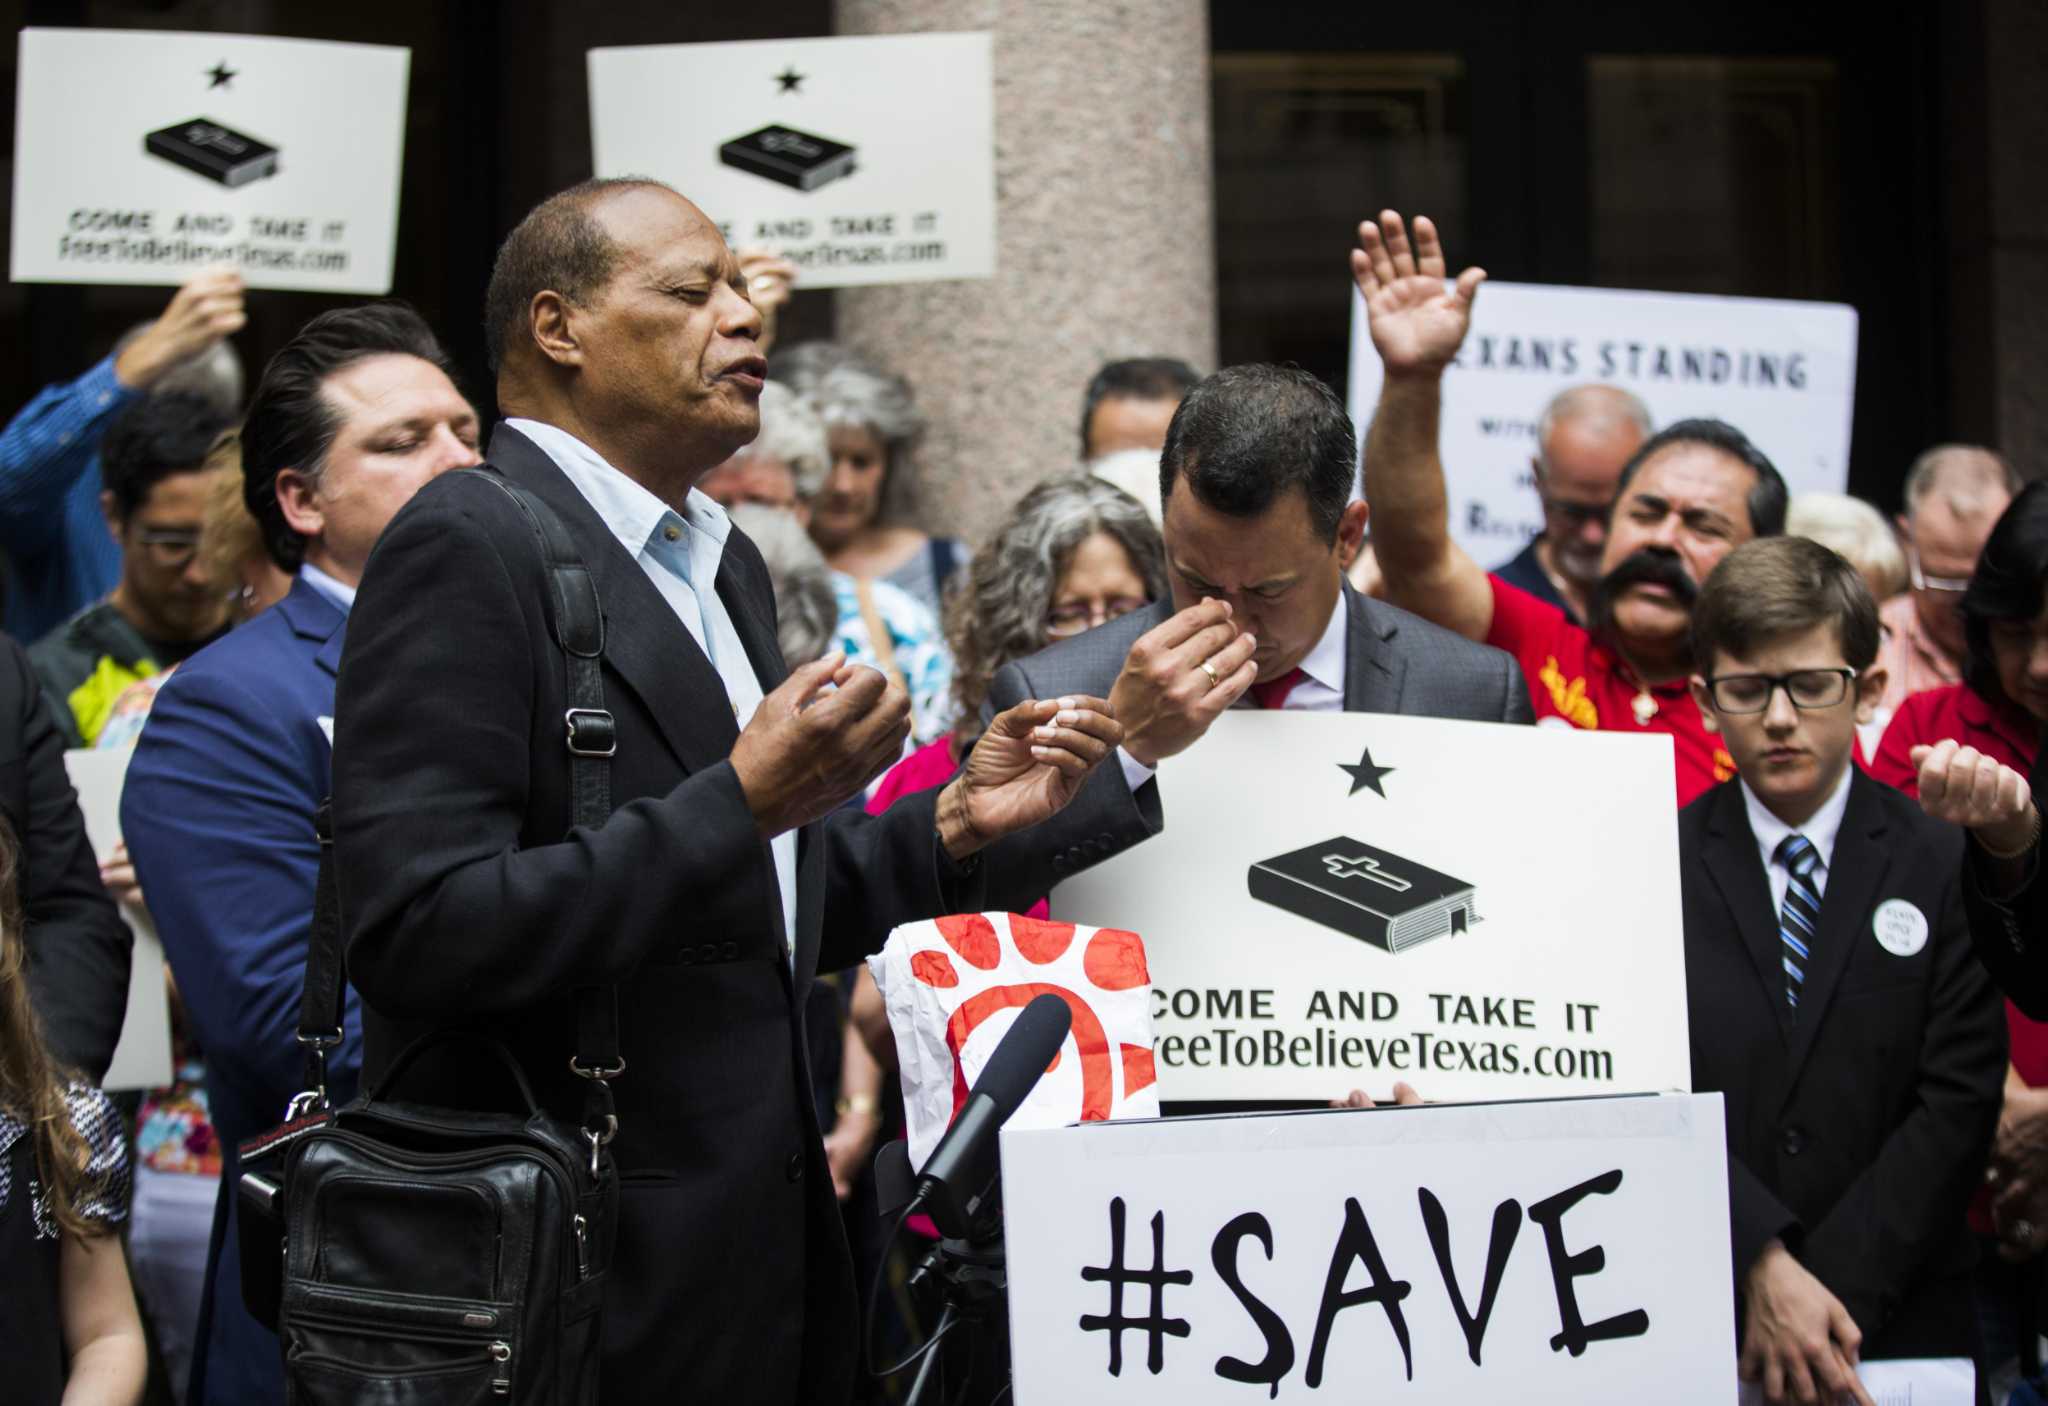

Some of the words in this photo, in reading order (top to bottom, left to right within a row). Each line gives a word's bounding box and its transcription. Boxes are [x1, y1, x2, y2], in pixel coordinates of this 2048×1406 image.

[69, 209, 153, 233] COME
[172, 214, 235, 235] AND
[249, 216, 310, 239] TAKE
[756, 219, 812, 238] AND
[829, 215, 895, 236] TAKE
[1456, 336, 1578, 376] XANS
[1600, 342, 1807, 389] STANDING
[1152, 989, 1276, 1020] COME
[1305, 990, 1400, 1021] AND
[1428, 993, 1537, 1030] TAKE
[1565, 1003, 1599, 1033] IT
[1153, 1028, 1615, 1080] eeToBelieveTexas.com
[1080, 1170, 1649, 1399] #SAVE
